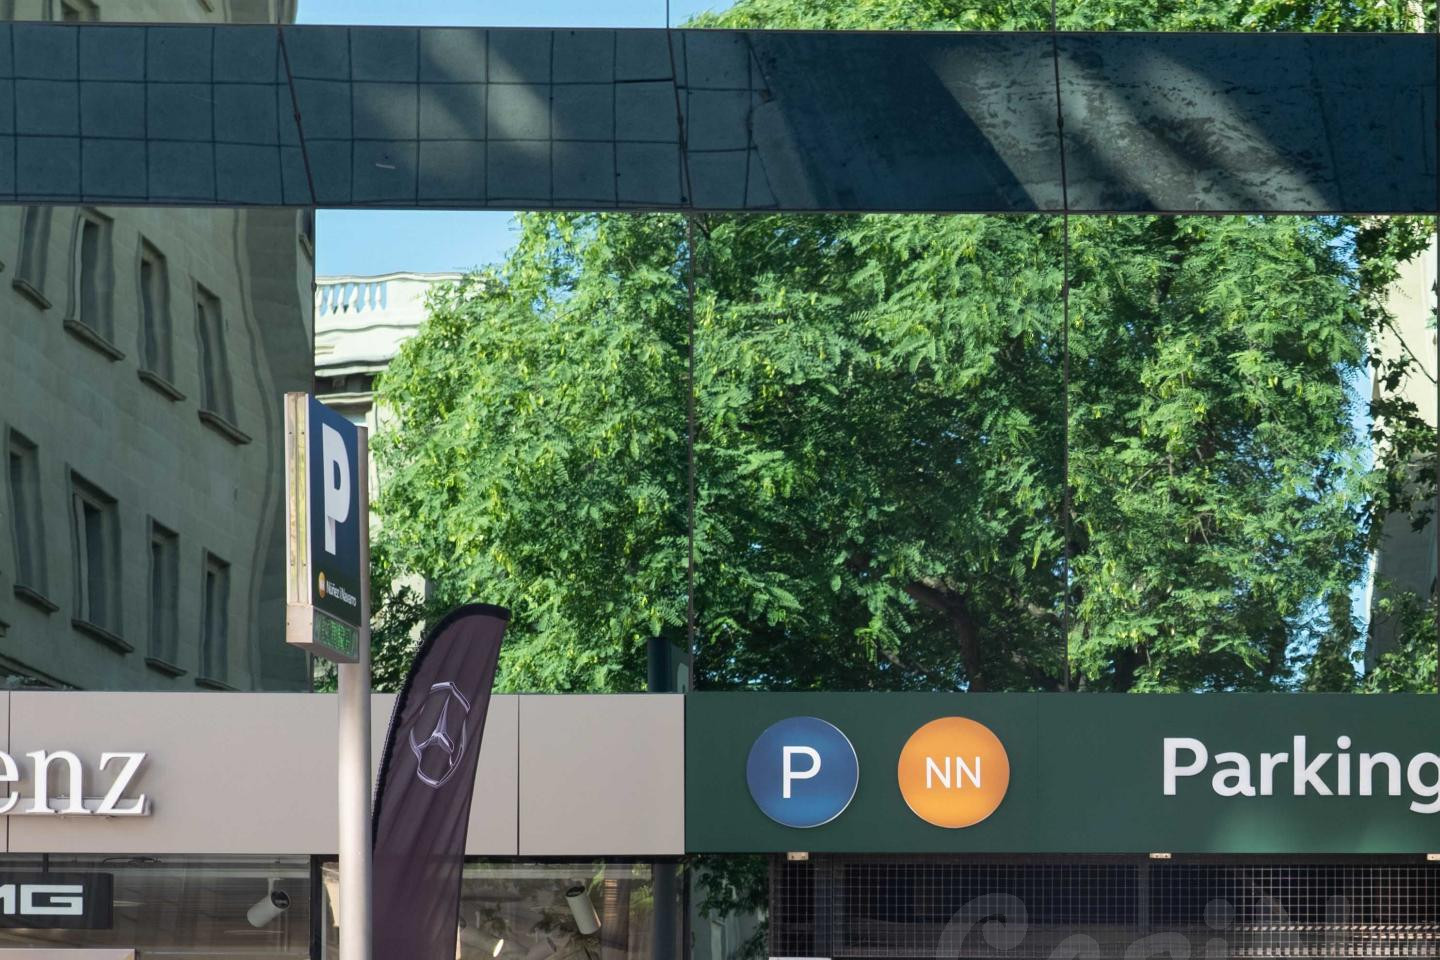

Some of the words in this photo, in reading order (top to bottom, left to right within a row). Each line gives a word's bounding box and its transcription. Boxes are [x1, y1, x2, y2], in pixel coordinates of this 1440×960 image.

[322, 422, 350, 556] P
[783, 746, 822, 798] P
[925, 756, 981, 788] NN
[0, 884, 83, 915] G
